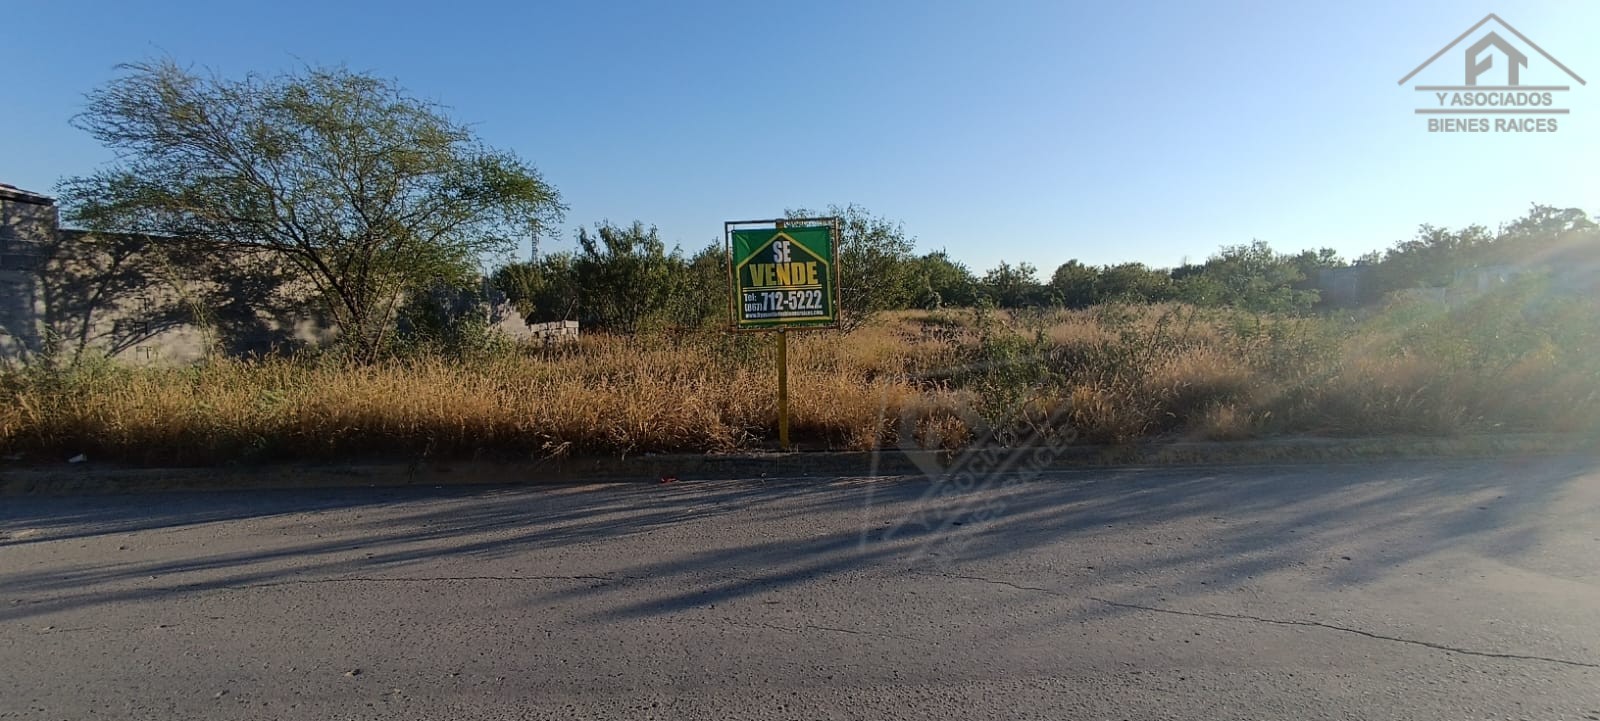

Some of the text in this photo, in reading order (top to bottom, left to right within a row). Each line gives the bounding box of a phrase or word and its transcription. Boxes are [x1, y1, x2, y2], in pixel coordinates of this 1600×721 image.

[772, 240, 792, 263] SE
[749, 261, 819, 287] VENDE
[744, 293, 757, 302] Tel:
[761, 290, 823, 311] 712-5222
